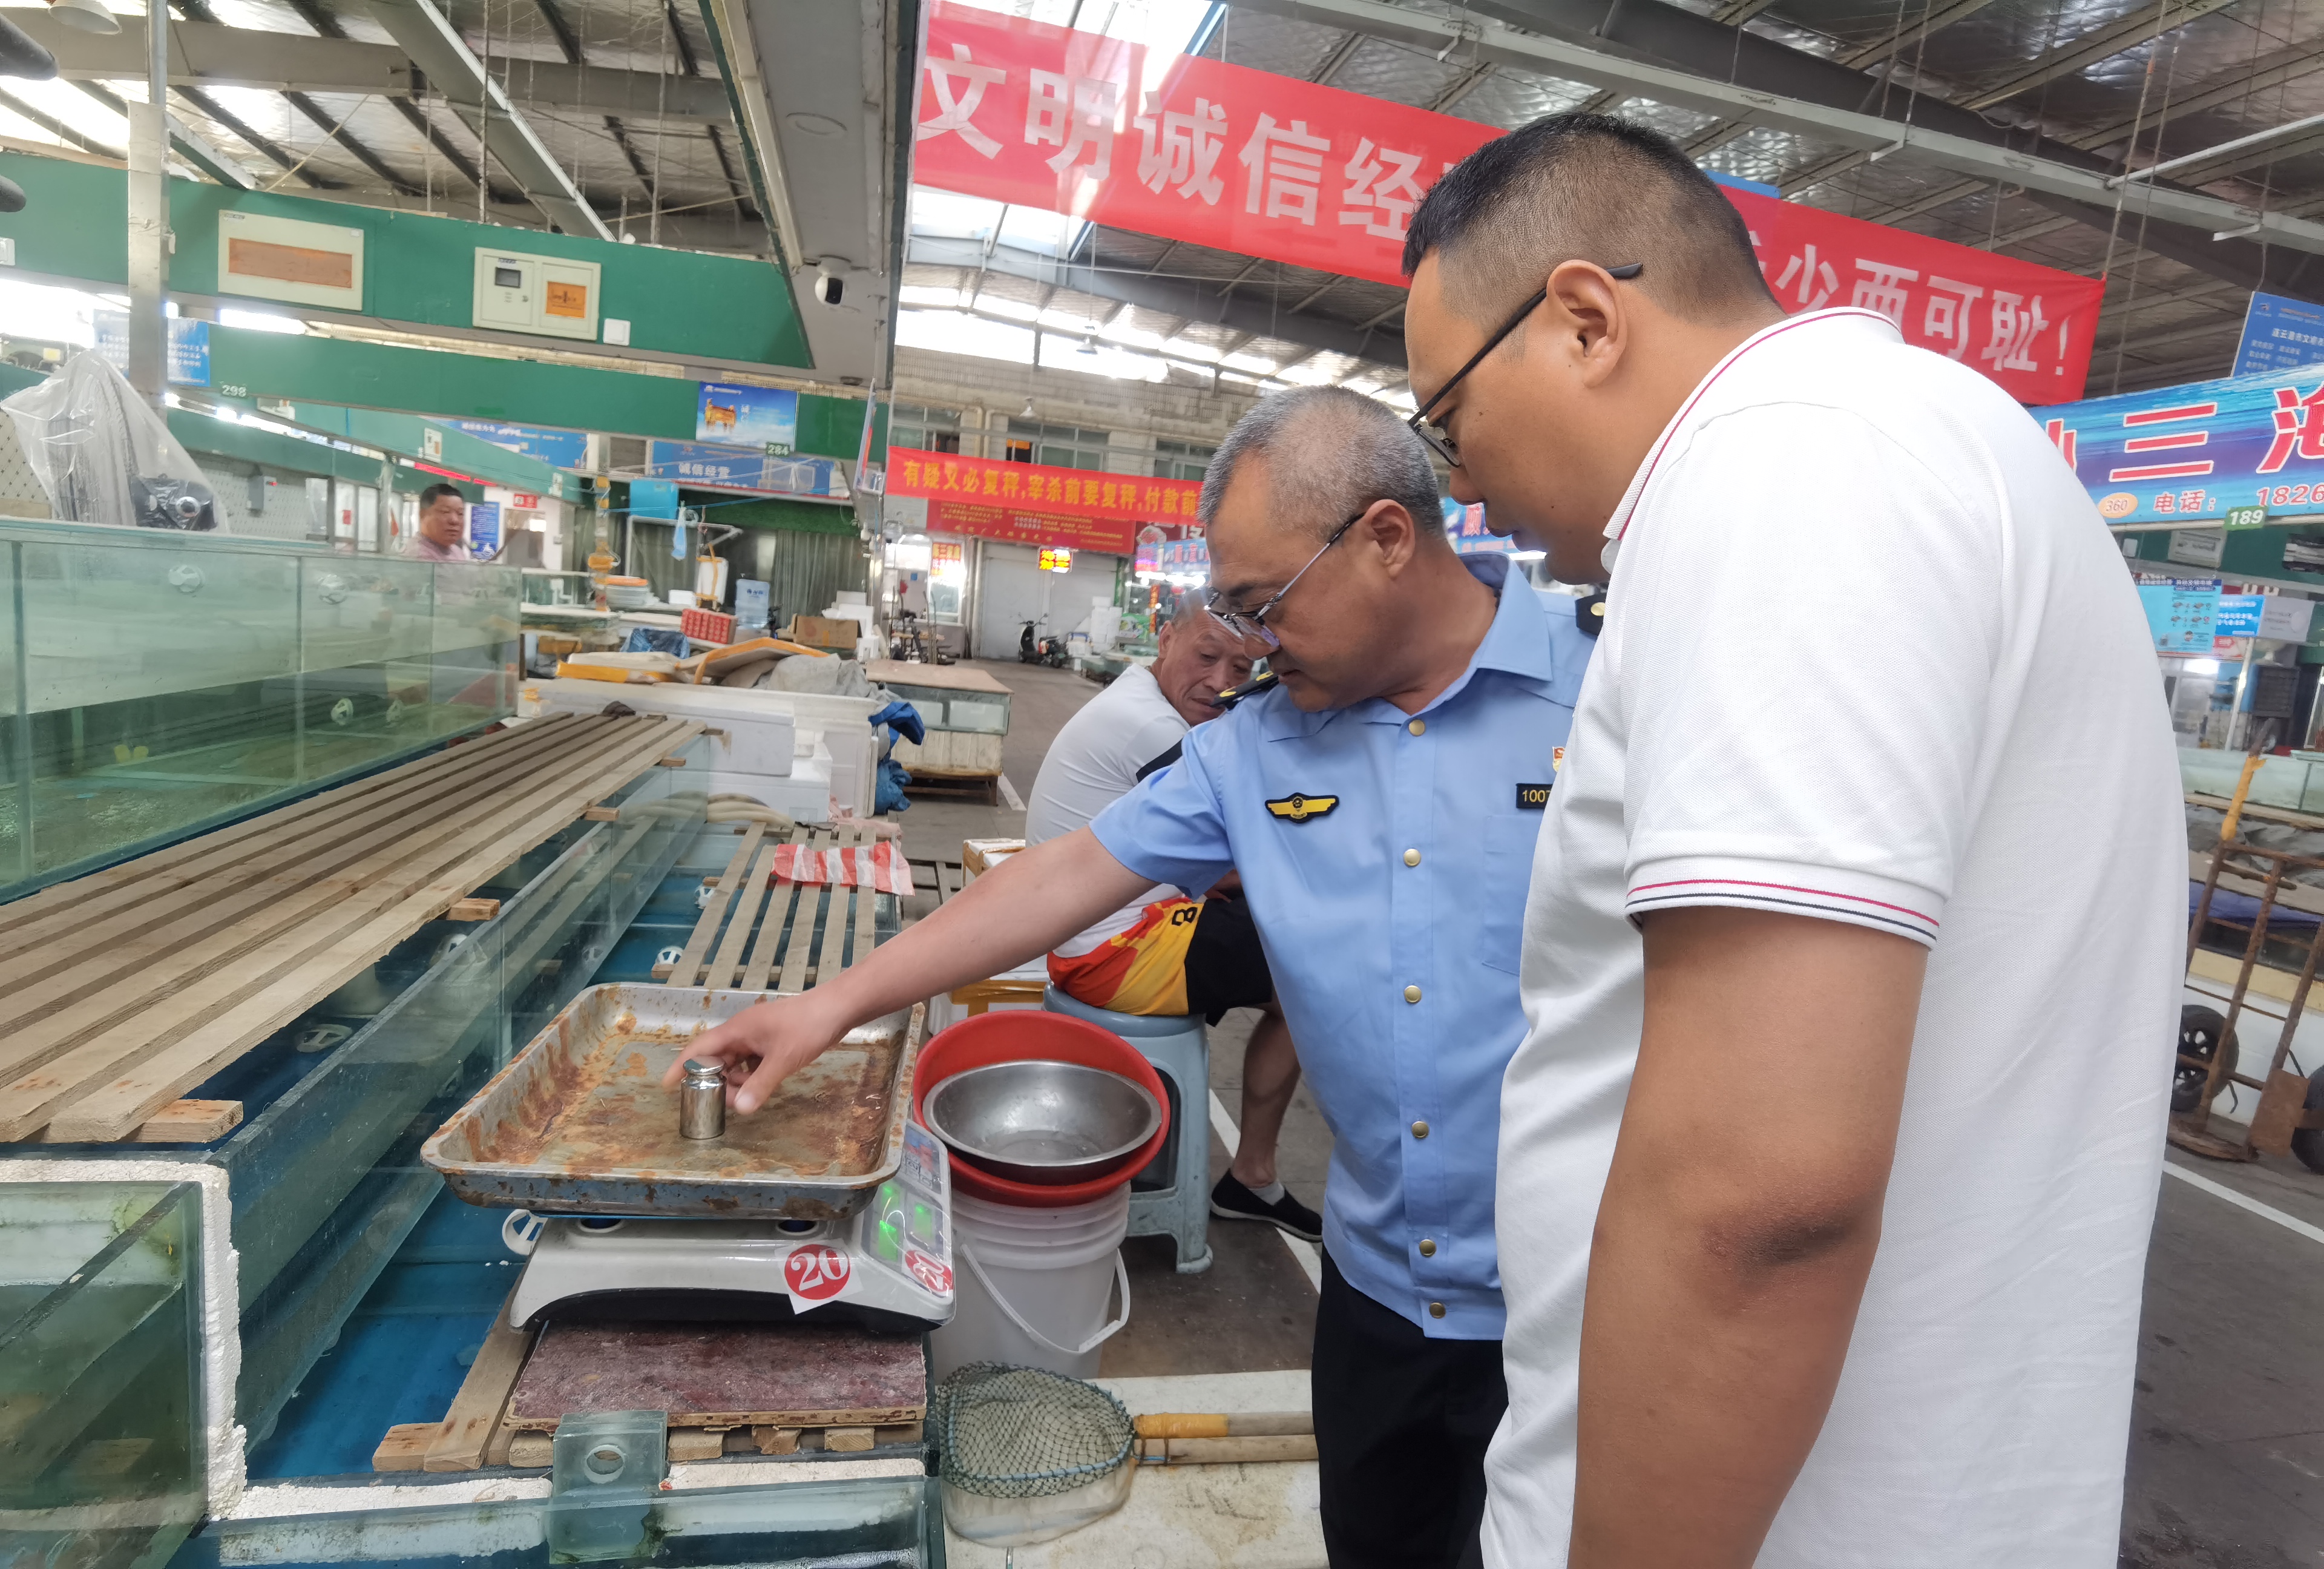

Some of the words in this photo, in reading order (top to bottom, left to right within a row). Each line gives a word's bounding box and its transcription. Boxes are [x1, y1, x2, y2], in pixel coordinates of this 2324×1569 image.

[916, 44, 1456, 242] 文明诚信经
[1748, 231, 2070, 376] 少两可耻！
[222, 385, 247, 397] 298
[767, 444, 790, 456] 284
[2153, 489, 2216, 514] 电话：
[2256, 482, 2324, 507] 1826
[2230, 510, 2264, 525] 189
[790, 1248, 849, 1291] 20
[913, 1251, 944, 1290] 20
